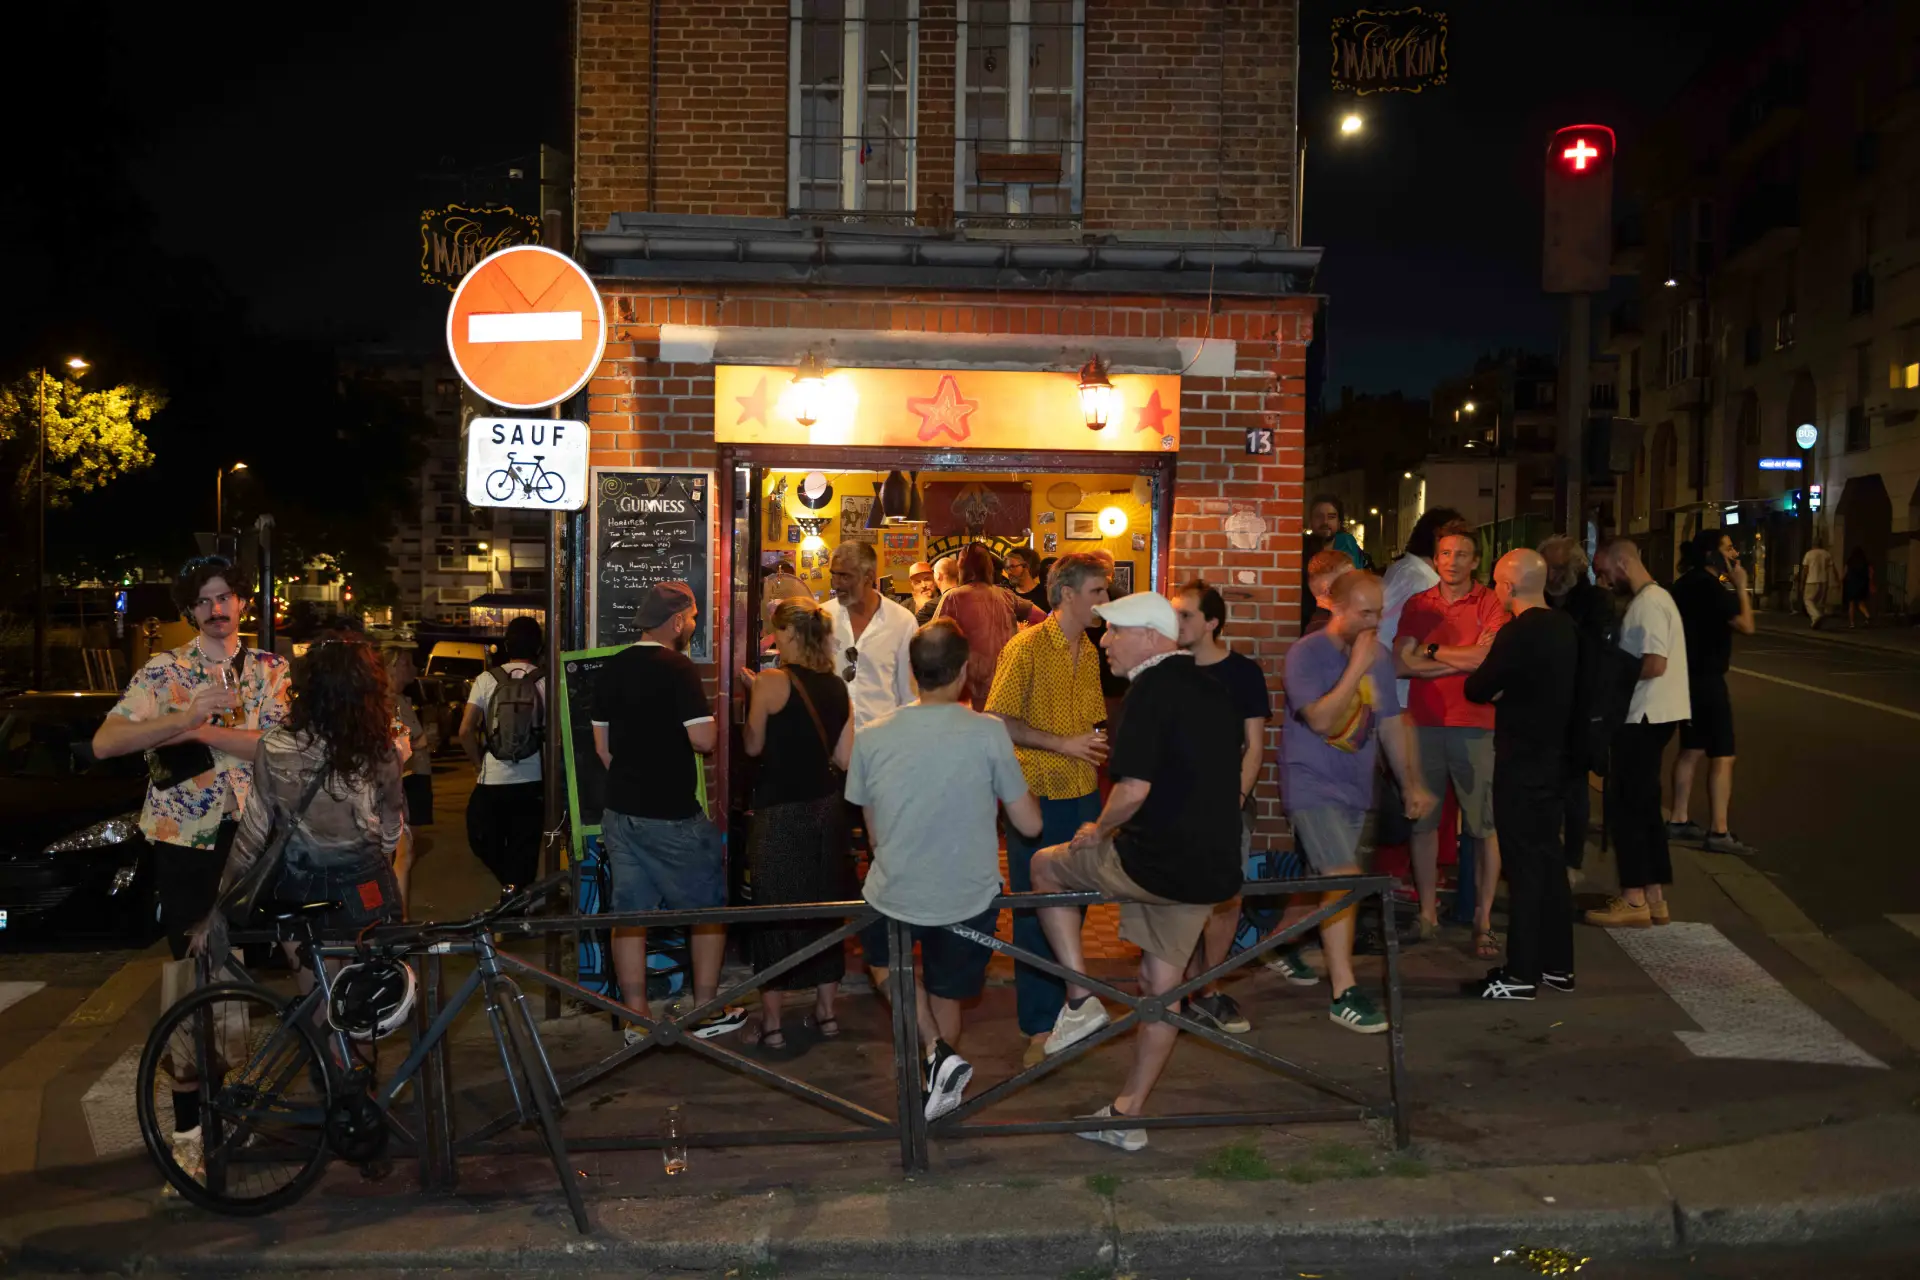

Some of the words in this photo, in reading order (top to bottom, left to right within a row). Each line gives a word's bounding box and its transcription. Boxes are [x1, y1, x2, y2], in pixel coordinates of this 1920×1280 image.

[1353, 21, 1429, 54] Café
[1342, 38, 1398, 81] MAMA
[1405, 33, 1437, 77] KIN
[491, 423, 565, 447] SAUF
[1247, 430, 1271, 454] 13
[1798, 429, 1815, 438] BUS
[620, 497, 685, 513] GUINNESS
